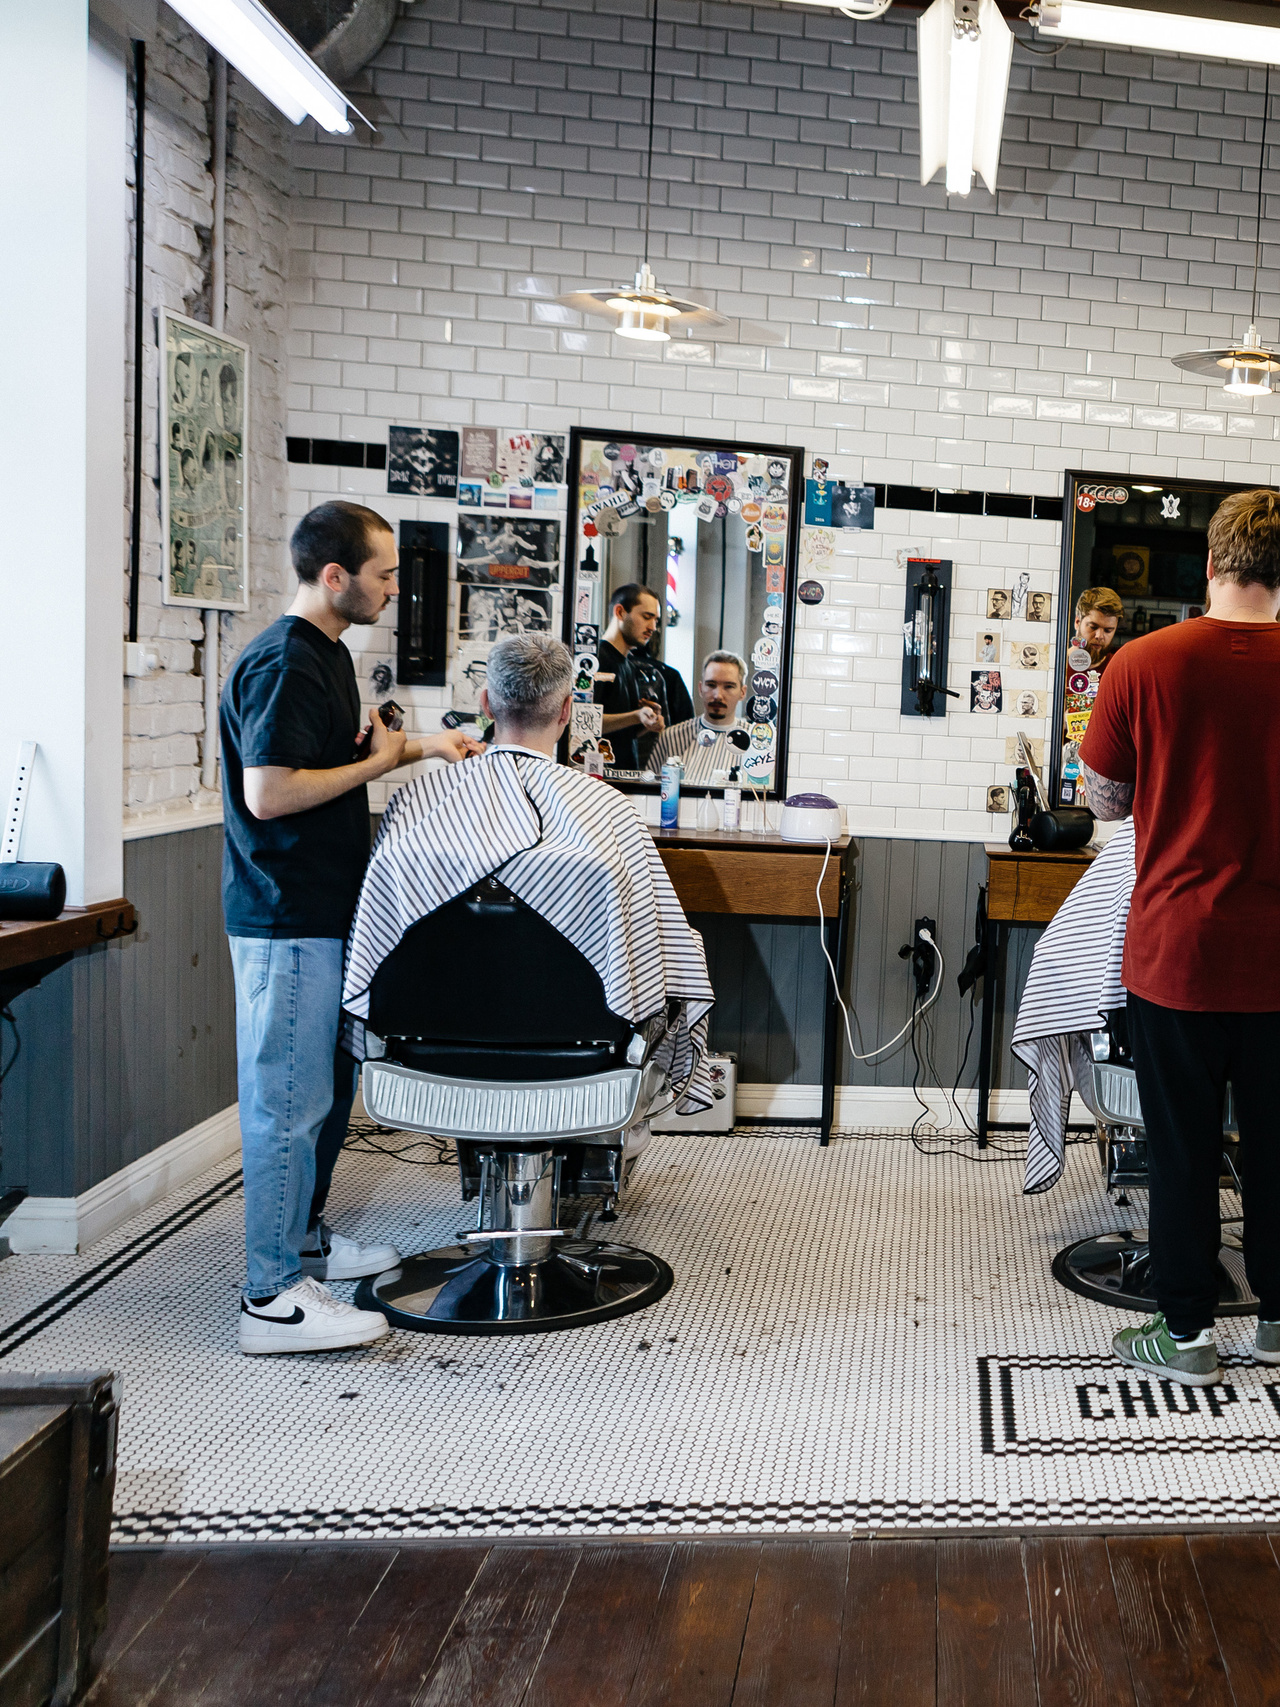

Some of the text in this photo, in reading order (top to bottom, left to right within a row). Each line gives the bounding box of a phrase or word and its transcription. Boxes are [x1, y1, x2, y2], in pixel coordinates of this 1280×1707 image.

[591, 495, 622, 512] WAHL
[1077, 496, 1096, 508] 18+
[490, 565, 528, 577] UPPERCUT
[753, 677, 776, 689] JVCR
